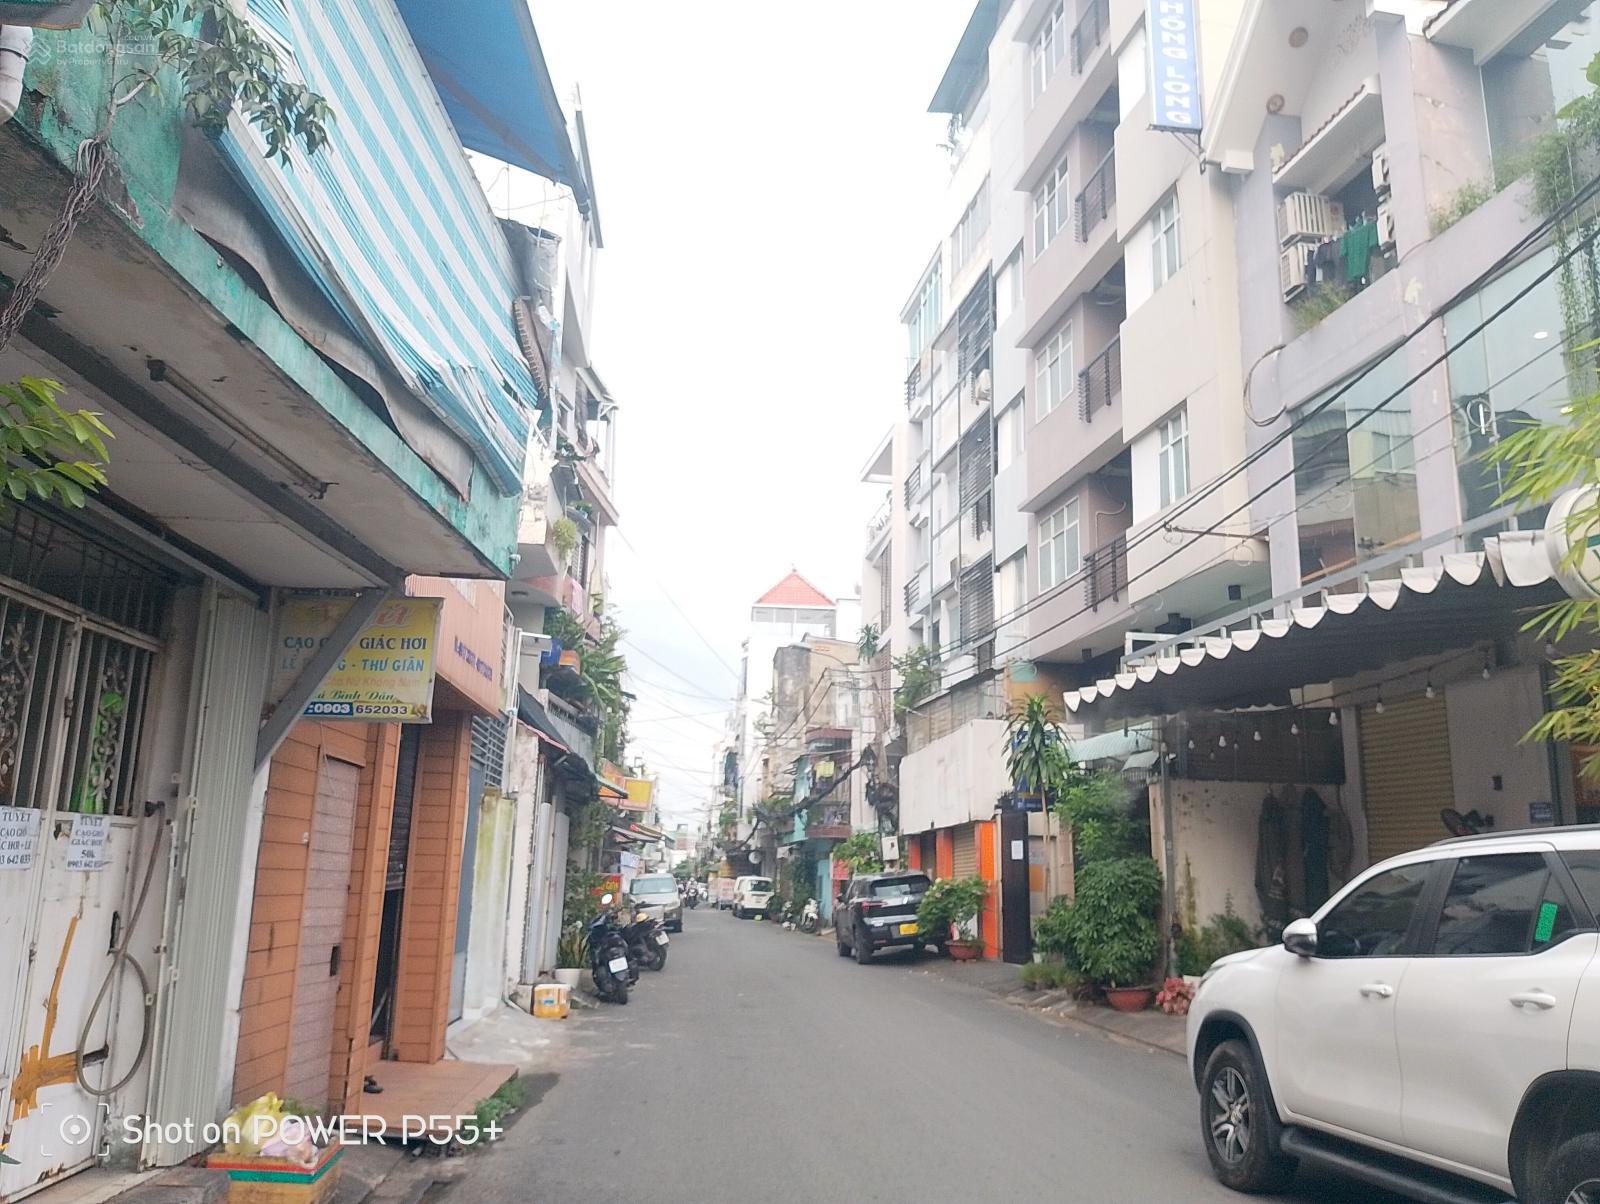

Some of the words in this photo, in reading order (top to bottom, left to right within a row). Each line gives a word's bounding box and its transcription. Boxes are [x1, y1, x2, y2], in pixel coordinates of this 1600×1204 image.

[359, 634, 396, 650] GIÁC
[400, 636, 427, 650] HƠI
[361, 658, 388, 672] THƯ
[392, 656, 424, 672] GIÃN
[355, 704, 408, 715] 652033
